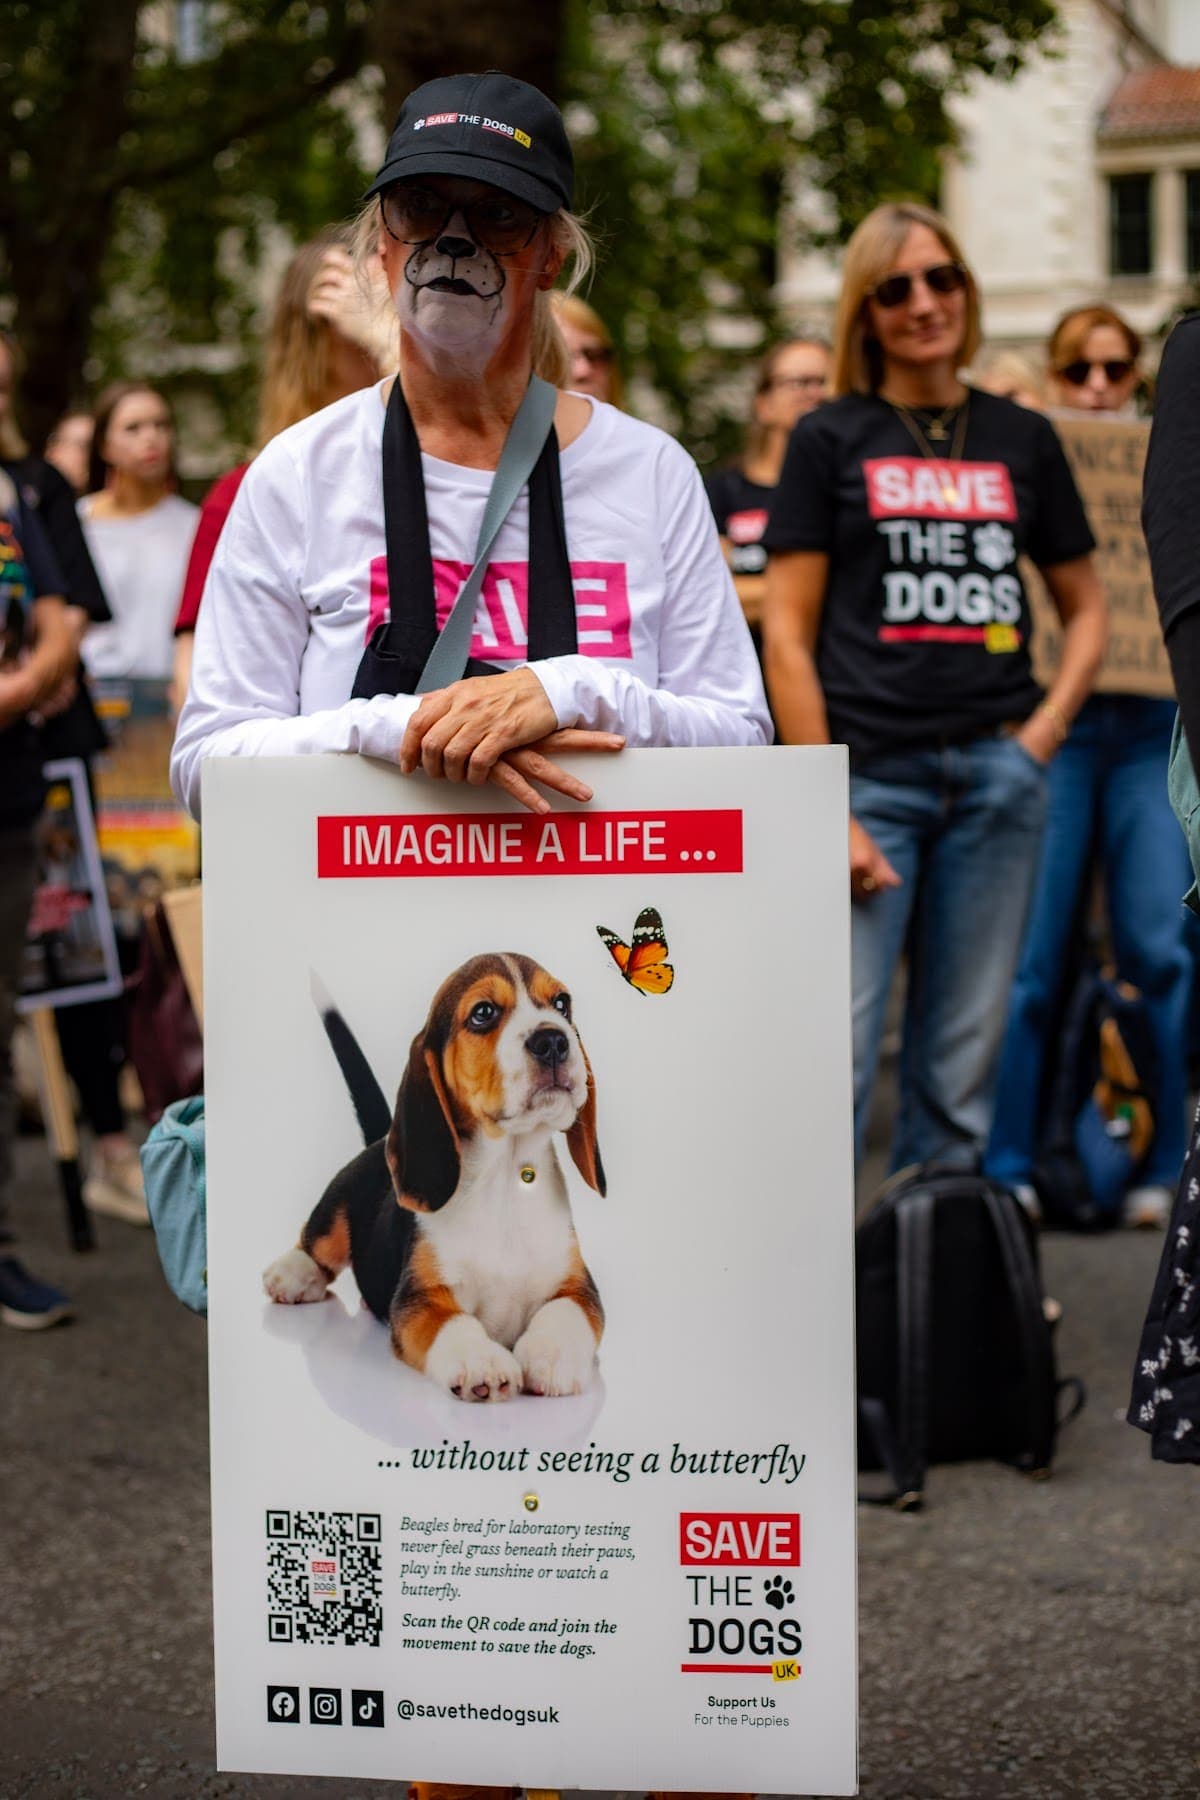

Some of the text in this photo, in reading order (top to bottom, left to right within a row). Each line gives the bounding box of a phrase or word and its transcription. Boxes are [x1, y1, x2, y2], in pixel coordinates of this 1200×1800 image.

[426, 113, 530, 145] SAVE THE DOGS UK
[873, 463, 1010, 515] SAVE
[876, 519, 968, 567] THE
[882, 570, 1021, 625] DOGS
[343, 823, 523, 865] IMAGINE
[535, 822, 566, 863] A
[579, 821, 667, 862] LIFE
[411, 1439, 530, 1472] without
[537, 1443, 634, 1483] seeing
[640, 1452, 660, 1474] a
[670, 1444, 806, 1484] butterfly
[400, 1517, 631, 1540] Beagles bred for laboratory testing
[686, 1520, 792, 1559] SAVE
[400, 1540, 636, 1562] never feel grass beneath their paws,
[400, 1561, 609, 1580] play in the sunshine or watch a
[401, 1582, 461, 1601] butterfly.
[686, 1575, 752, 1605] THE
[402, 1614, 617, 1636] Scan the QR code and join the
[689, 1618, 802, 1655] DOGS
[402, 1637, 596, 1659] movement to save the dogs.
[776, 1664, 795, 1678] UK
[397, 1699, 559, 1726] @savethedogsuk
[708, 1696, 776, 1709] Support Us
[695, 1714, 789, 1728] For the Puppies
